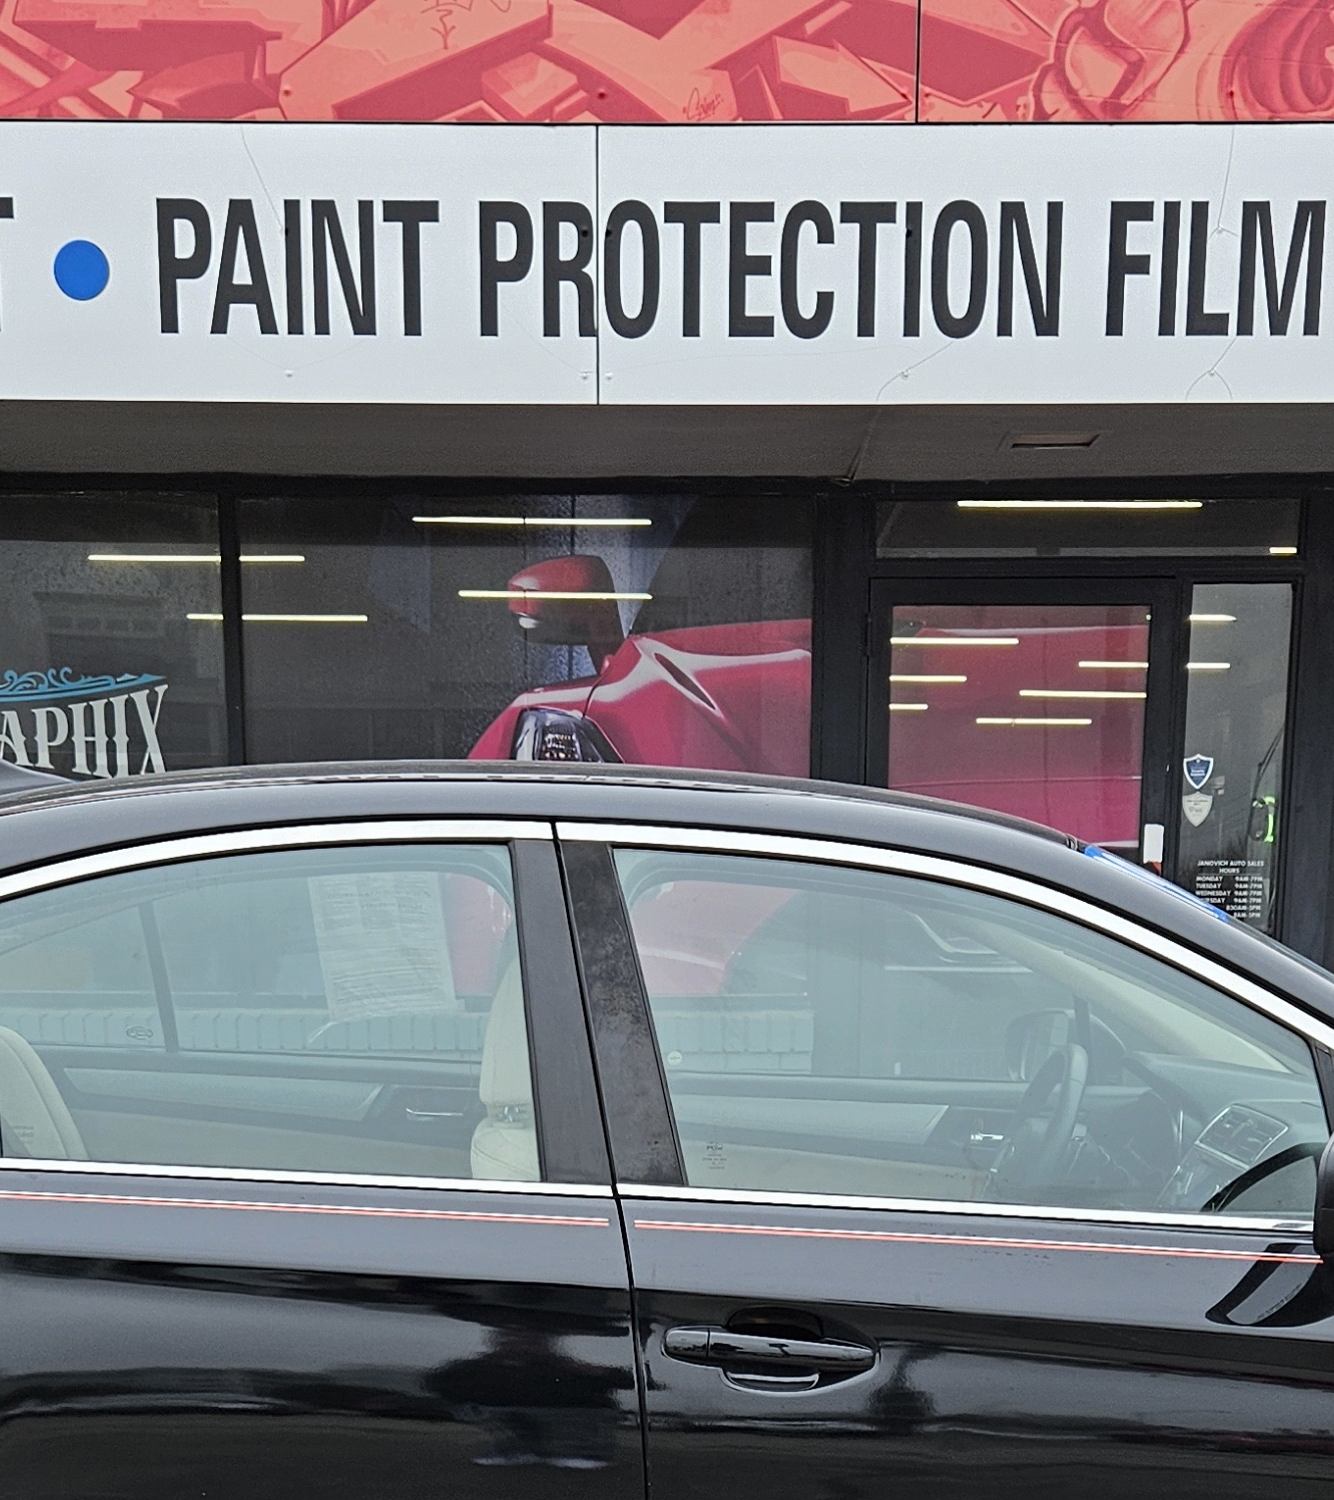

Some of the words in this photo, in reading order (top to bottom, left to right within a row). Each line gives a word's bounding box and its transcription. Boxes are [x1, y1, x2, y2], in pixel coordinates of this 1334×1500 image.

[155, 197, 440, 337] PAINT
[478, 199, 1064, 339] PROTECTION
[1105, 200, 1327, 337] FILM
[1229, 860, 1247, 868] AUTO
[1247, 860, 1265, 868] SALES
[1219, 867, 1240, 875] HOURS
